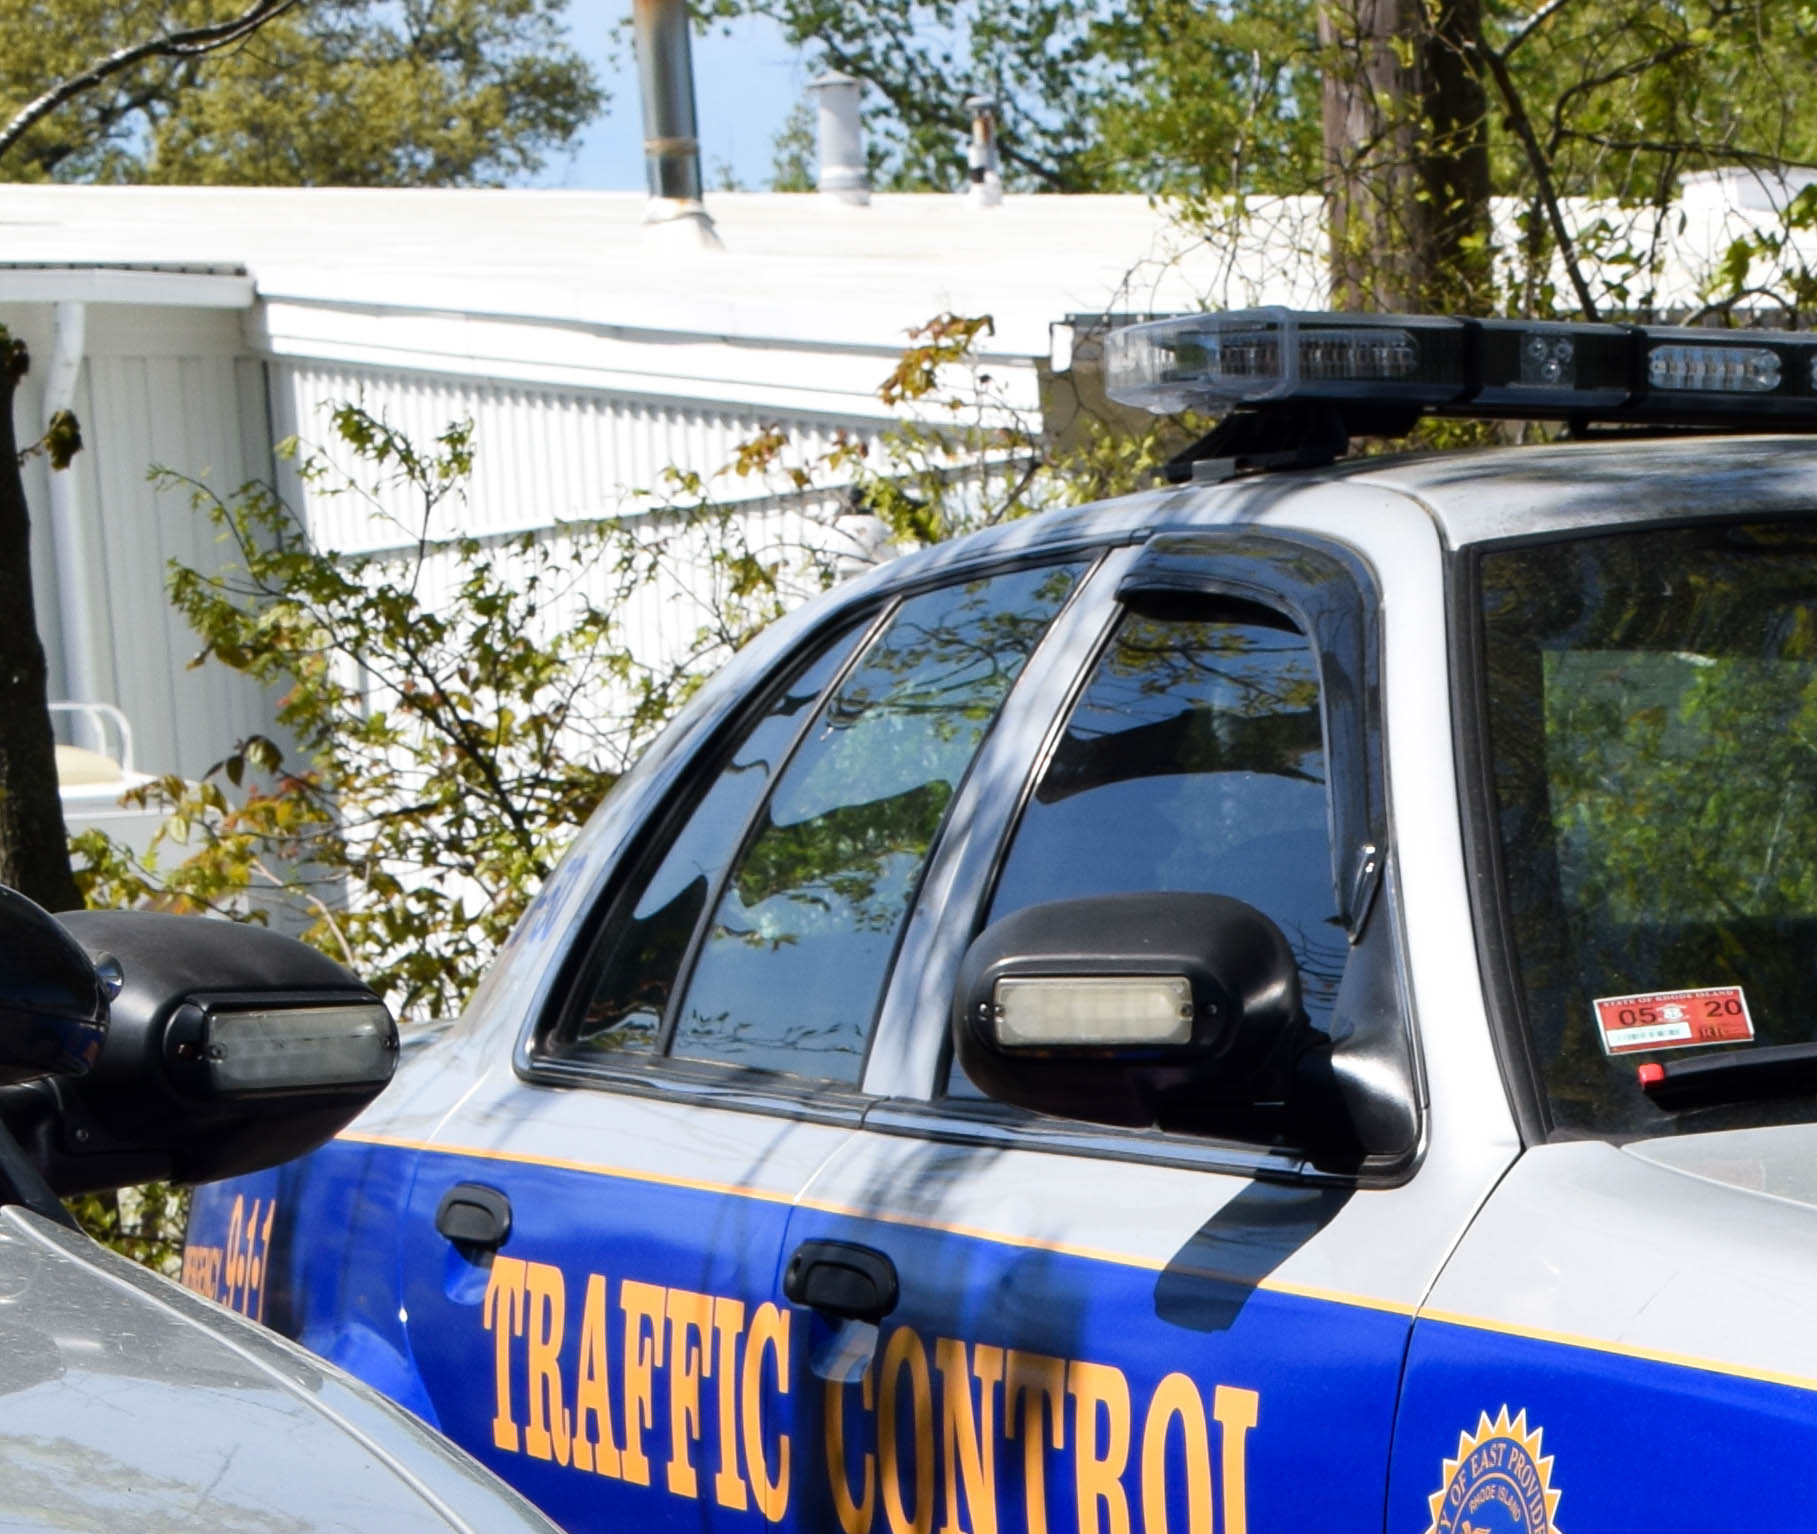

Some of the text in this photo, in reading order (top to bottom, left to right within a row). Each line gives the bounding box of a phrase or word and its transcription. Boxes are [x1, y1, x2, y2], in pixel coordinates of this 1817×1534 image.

[1603, 999, 1637, 1008] STATE
[1704, 998, 1742, 1018] 20
[1618, 1007, 1656, 1026] 05
[483, 1256, 792, 1523] TRAFFIC
[1451, 1469, 1466, 1506] OF
[1471, 1443, 1507, 1479] EAST
